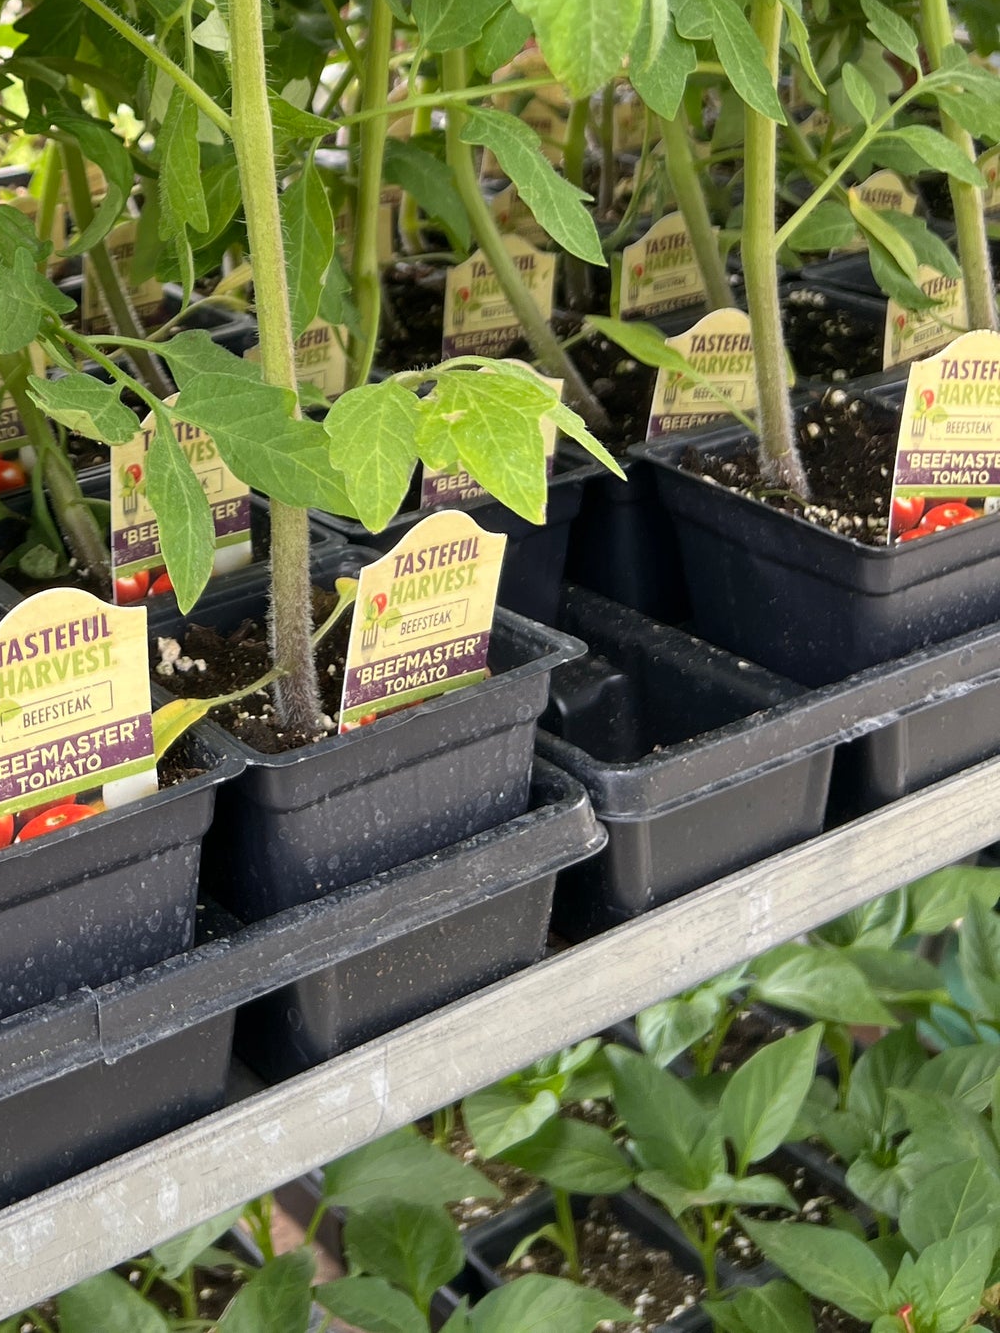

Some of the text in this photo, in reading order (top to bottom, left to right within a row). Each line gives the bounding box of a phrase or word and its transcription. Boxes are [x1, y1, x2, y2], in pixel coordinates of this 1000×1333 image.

[690, 334, 753, 353] TASTEFU
[941, 359, 1000, 380] TASTEF
[946, 421, 992, 435] BEEFSTEAK
[931, 470, 990, 485] TOMATO
[393, 536, 480, 579] TASTEFUL
[399, 609, 453, 636] BEEFSTEAK
[384, 664, 448, 695] TOMATO
[23, 694, 92, 729] BEEFSTEAK
[16, 754, 102, 794] TOMATO
